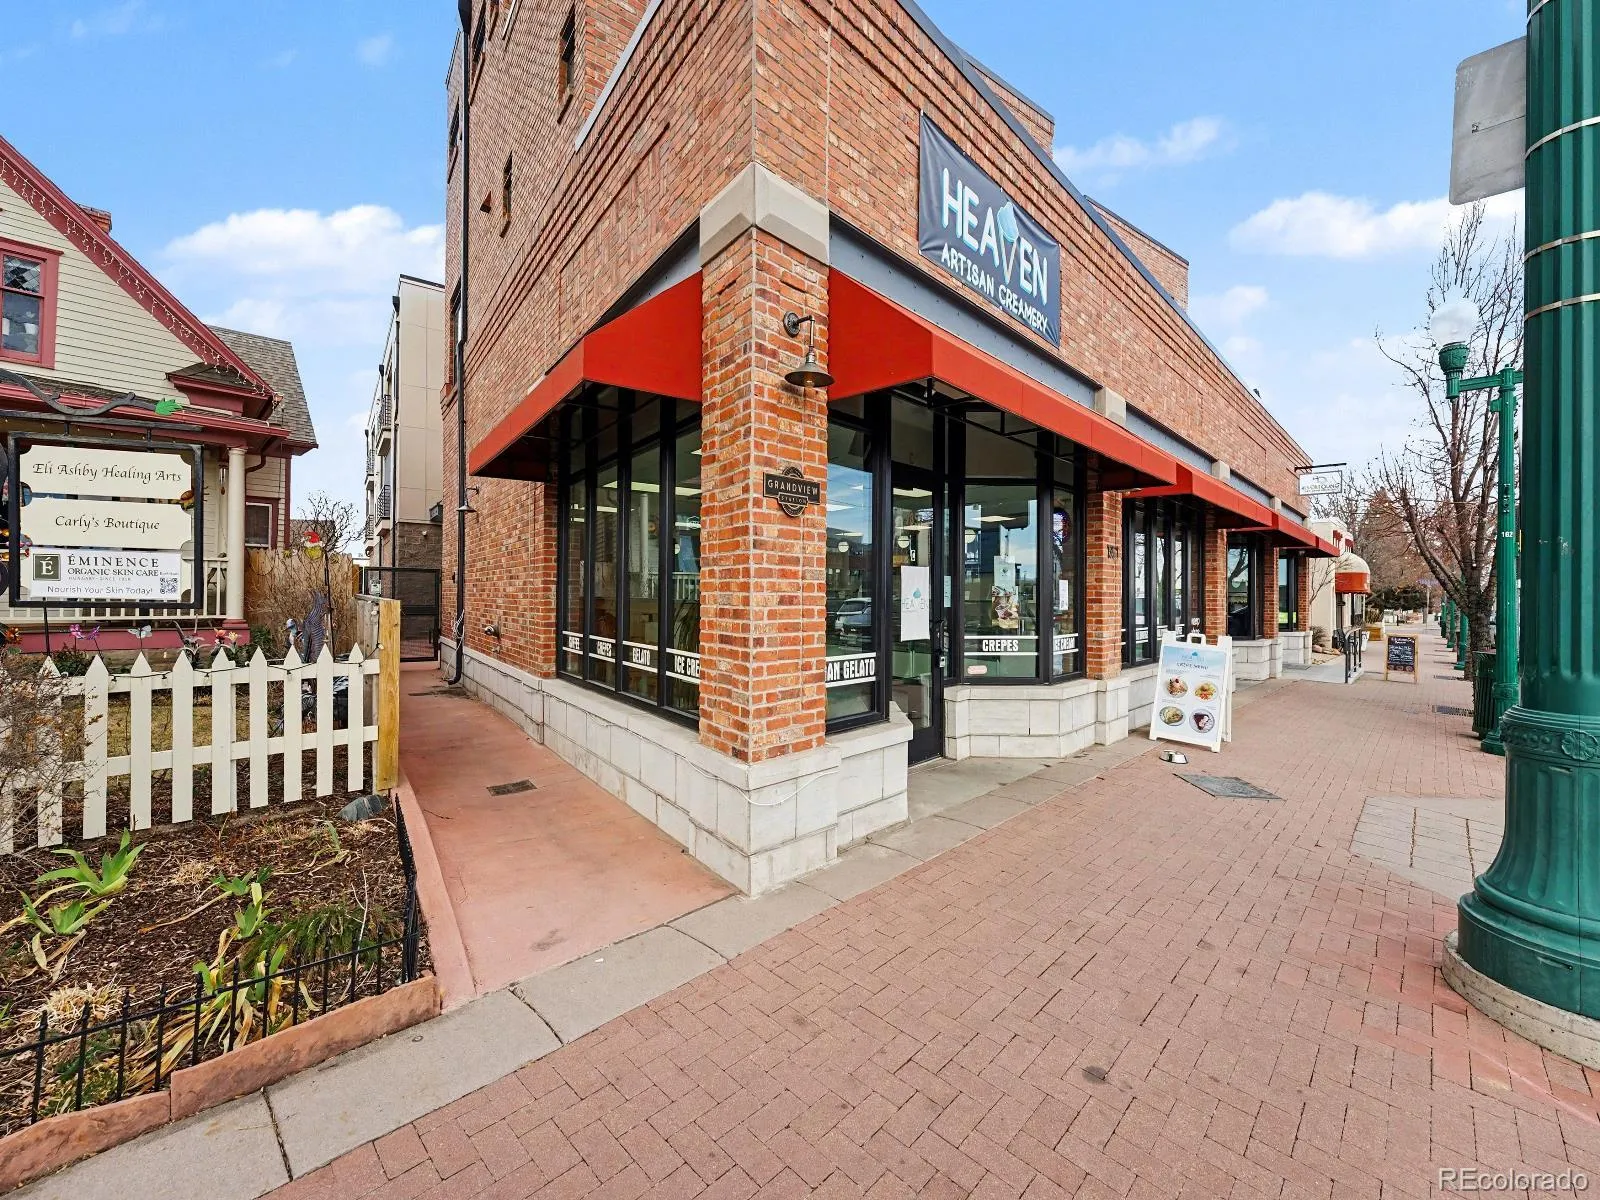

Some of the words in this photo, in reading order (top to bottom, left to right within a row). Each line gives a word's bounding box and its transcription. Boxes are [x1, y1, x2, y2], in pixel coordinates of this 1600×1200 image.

[942, 168, 1048, 305] HEAVEN
[941, 243, 995, 297] ARTISAN
[999, 285, 1048, 334] CREAMERY
[32, 460, 52, 474] Eli
[57, 462, 98, 482] Ashby
[101, 465, 151, 484] Healing
[155, 469, 182, 482] Arts
[767, 479, 818, 496] GRANDVIEW
[55, 514, 100, 532] Carly's
[103, 517, 160, 533] Boutique
[40, 556, 54, 576] É
[68, 555, 159, 568] ÉMINENCE
[67, 567, 110, 576] ORGANIC
[112, 568, 134, 576] SKIN
[135, 569, 159, 577] CARE
[47, 585, 82, 594] Nourish
[84, 586, 103, 594] Your
[105, 586, 124, 594] Skin
[126, 587, 153, 595] Today!
[982, 639, 1018, 652] CREPES
[632, 648, 651, 666] GELATO
[674, 655, 685, 674] ICE
[843, 658, 875, 679] GELATO
